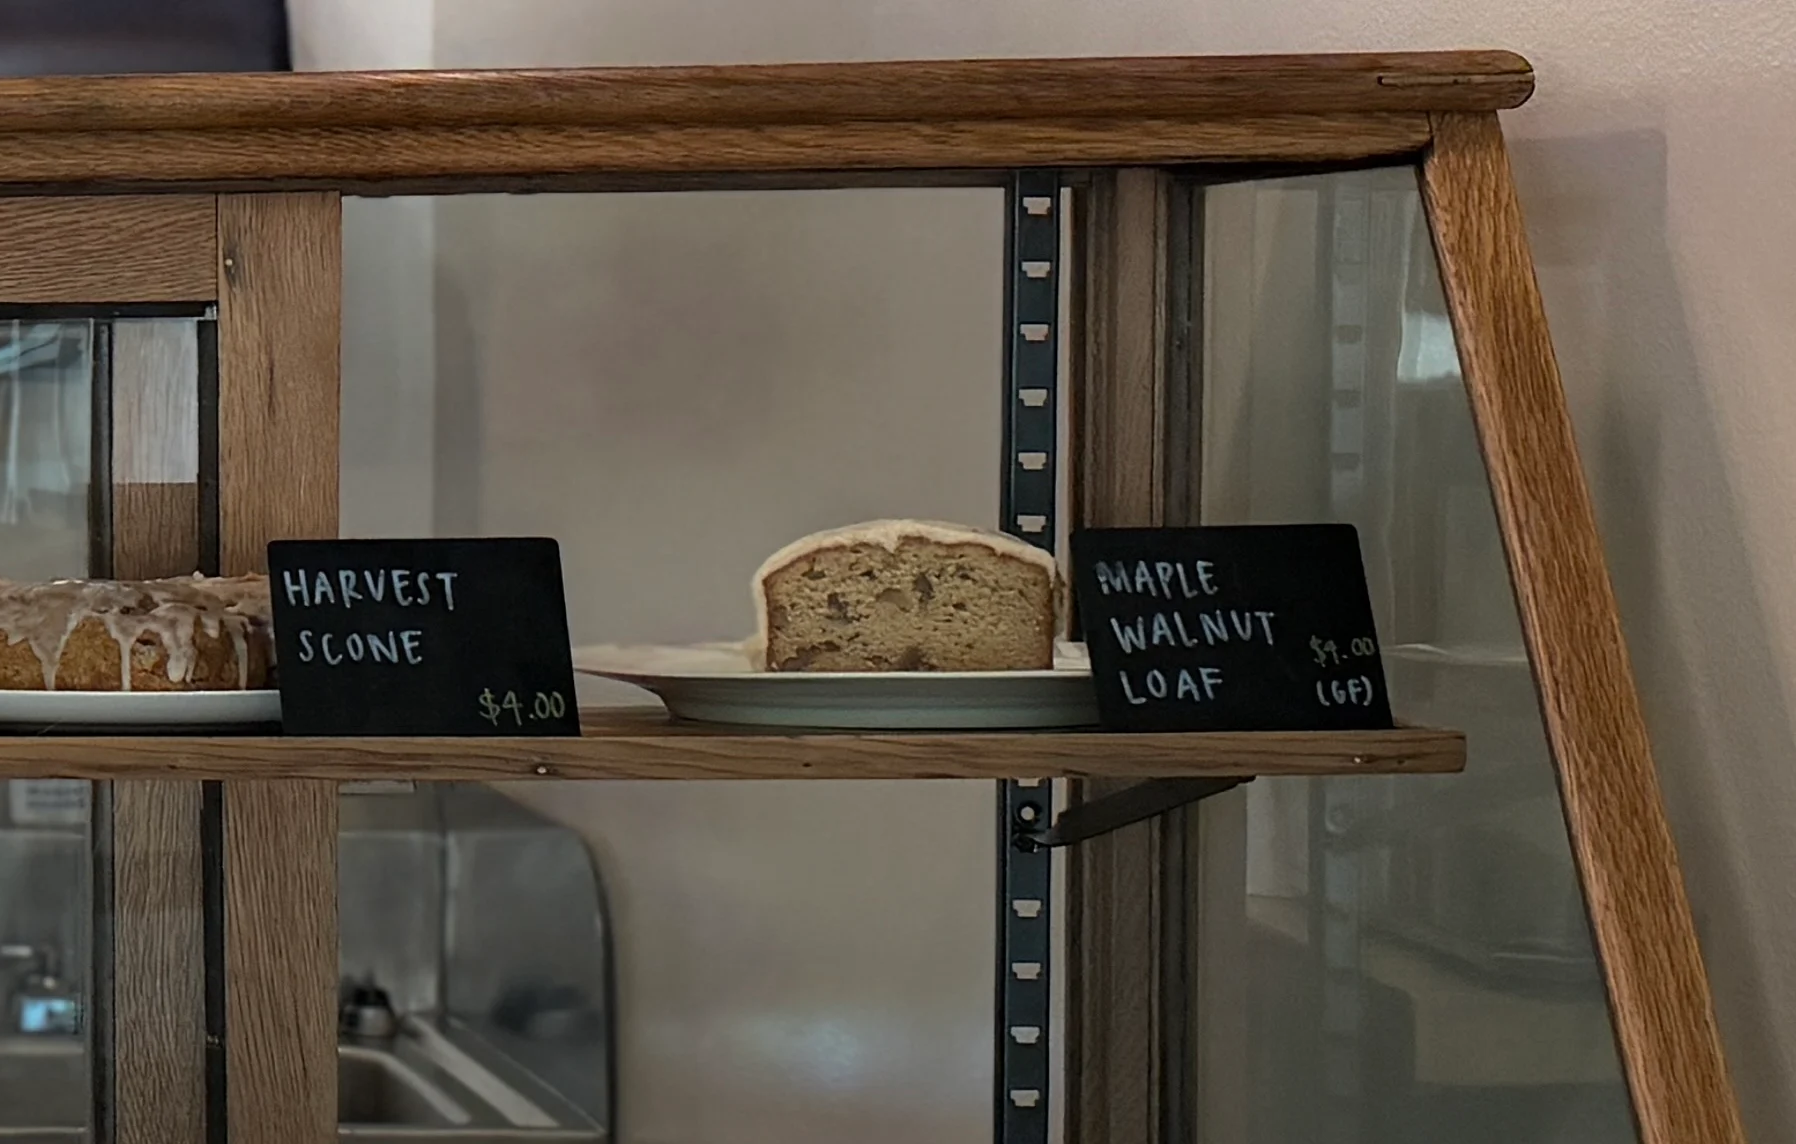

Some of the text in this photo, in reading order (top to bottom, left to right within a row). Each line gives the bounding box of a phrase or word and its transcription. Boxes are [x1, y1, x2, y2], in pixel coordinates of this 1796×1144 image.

[283, 569, 458, 611] HARVEST
[1095, 560, 1219, 599] MAPLE
[298, 630, 423, 665] SCONE
[1110, 610, 1276, 654] WALNUT
[1119, 667, 1224, 705] LOAF
[1315, 674, 1374, 707] (GF)
[478, 687, 566, 727] $4.00
